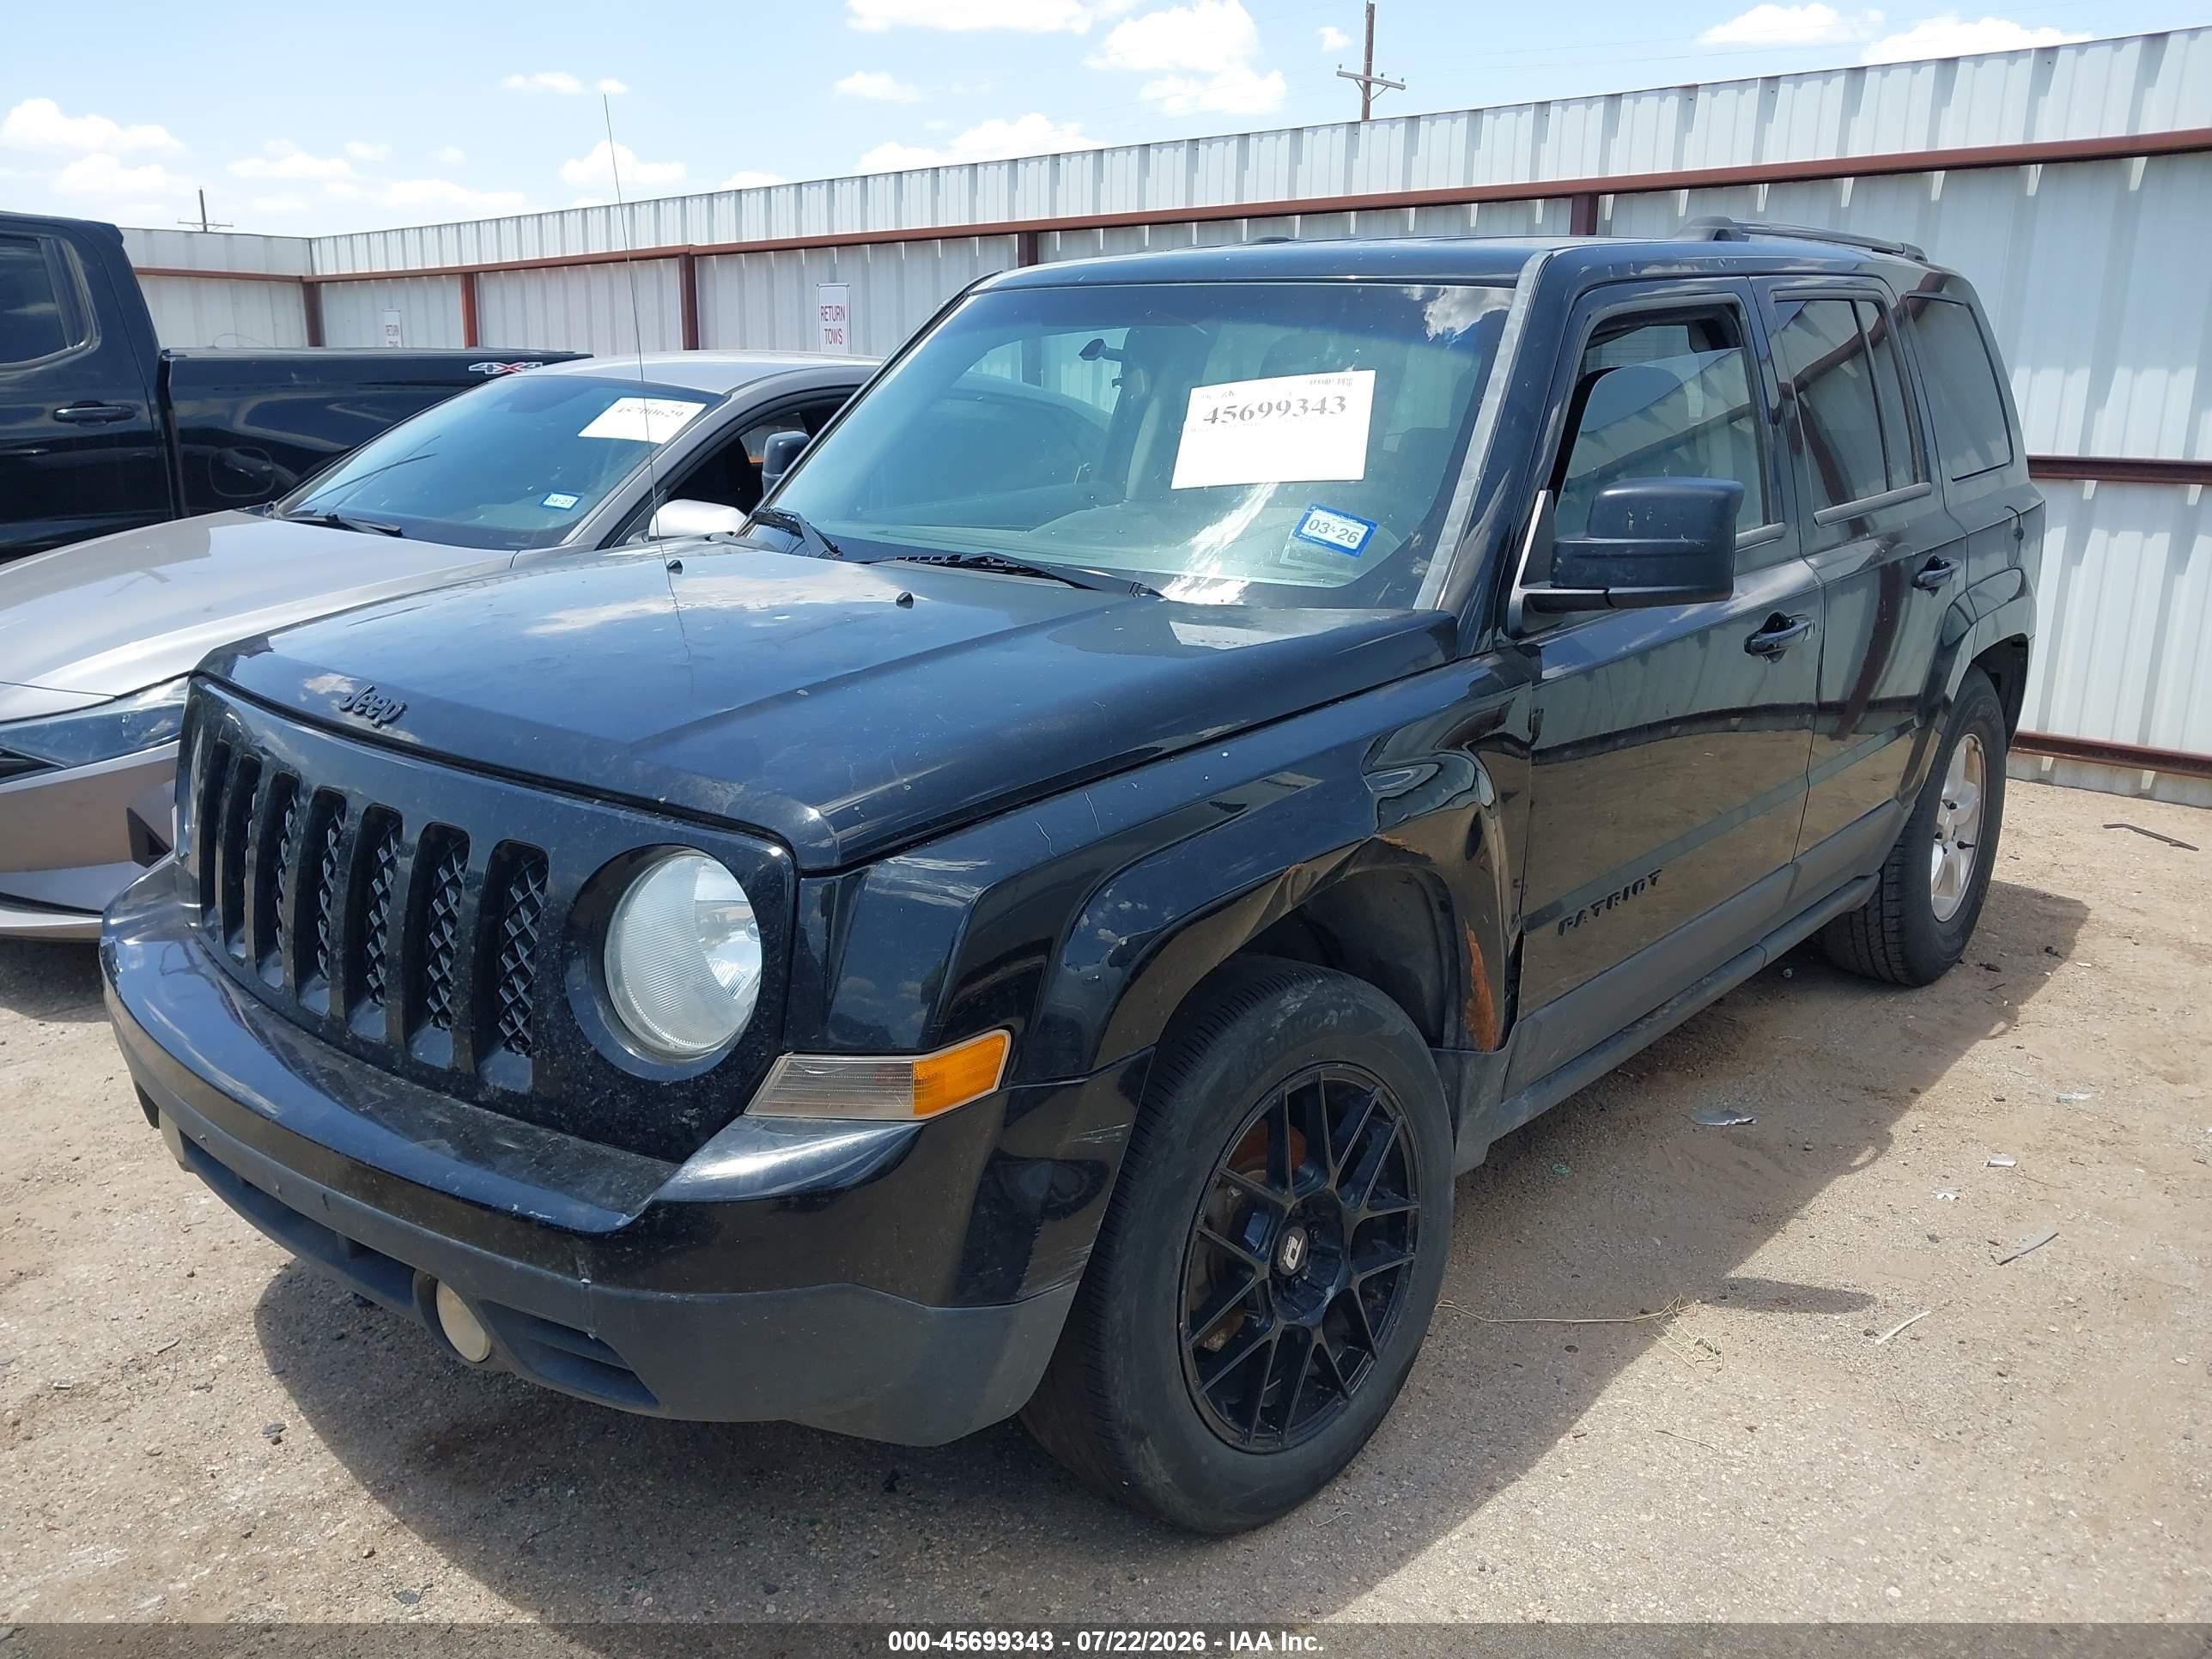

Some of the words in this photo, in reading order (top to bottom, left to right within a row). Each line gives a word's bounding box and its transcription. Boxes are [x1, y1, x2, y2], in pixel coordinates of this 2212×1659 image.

[819, 305, 846, 322] RETURN
[824, 328, 843, 345] TOWS
[1203, 395, 1346, 424] 45699343
[338, 684, 408, 729] Jeep
[1557, 868, 1663, 937] PATRIOT
